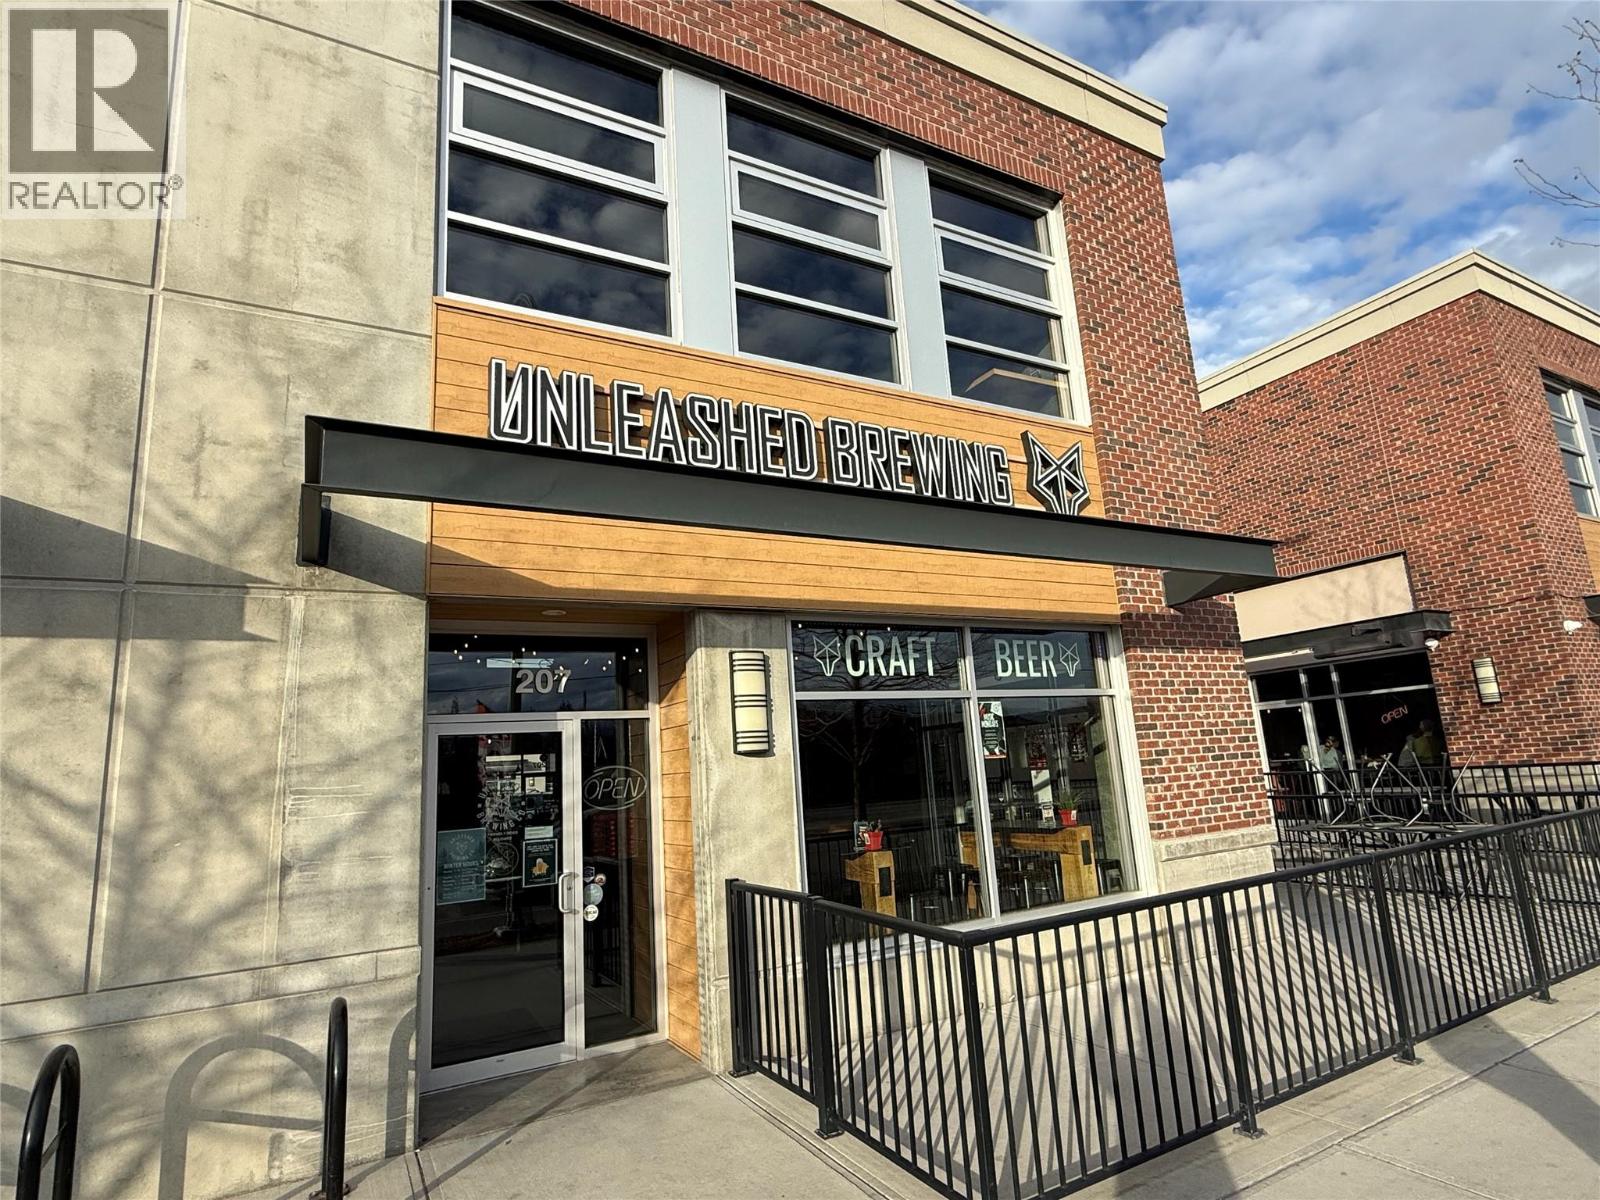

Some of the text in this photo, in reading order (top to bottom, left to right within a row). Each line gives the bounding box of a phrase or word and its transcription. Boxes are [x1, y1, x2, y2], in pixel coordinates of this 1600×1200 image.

[488, 358, 1015, 507] UNLEASHED BREWING
[845, 634, 1058, 677] CRAFT BEER
[515, 668, 572, 694] 207
[1381, 704, 1409, 725] OPEN
[584, 776, 641, 801] OPEN
